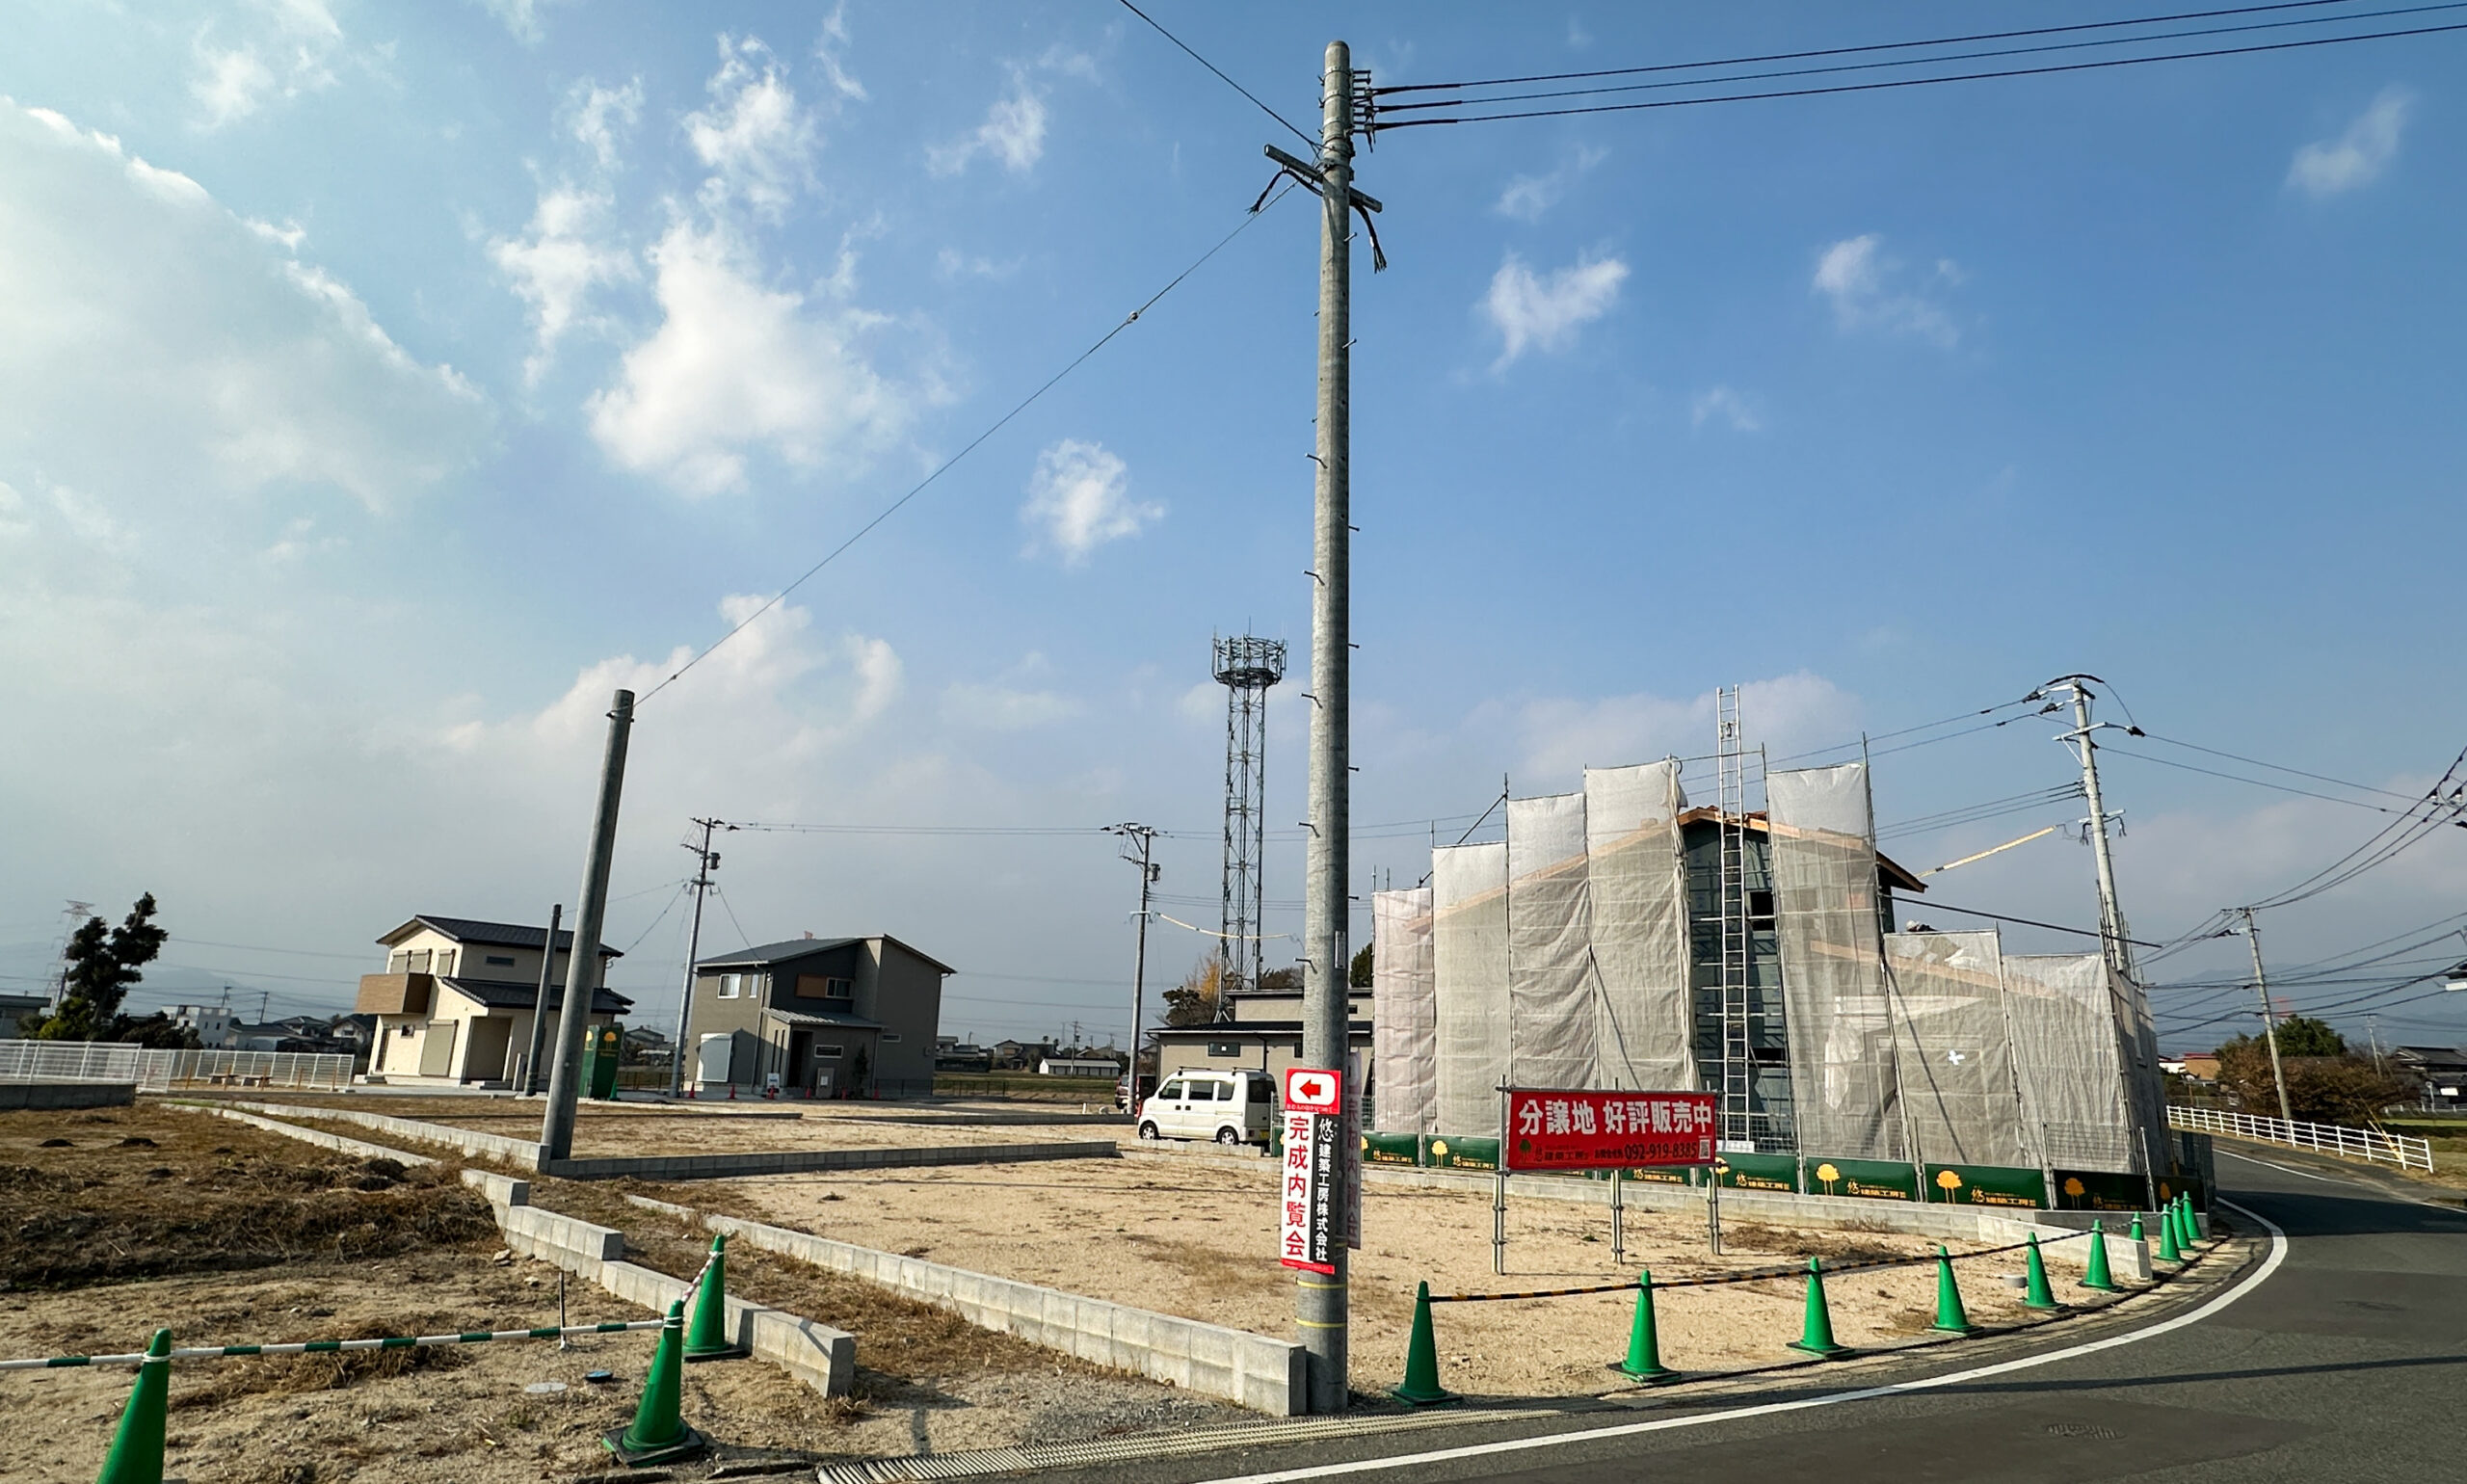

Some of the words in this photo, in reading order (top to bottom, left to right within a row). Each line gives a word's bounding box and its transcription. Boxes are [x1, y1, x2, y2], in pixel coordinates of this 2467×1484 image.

[1519, 1100, 1596, 1135] 分譲地
[1603, 1100, 1711, 1135] 好評販売中
[1624, 1143, 1697, 1160] 092-919-8385
[1286, 1116, 1310, 1258] 完成内覧会
[1315, 1117, 1334, 1262] 悠建築工房株式会社
